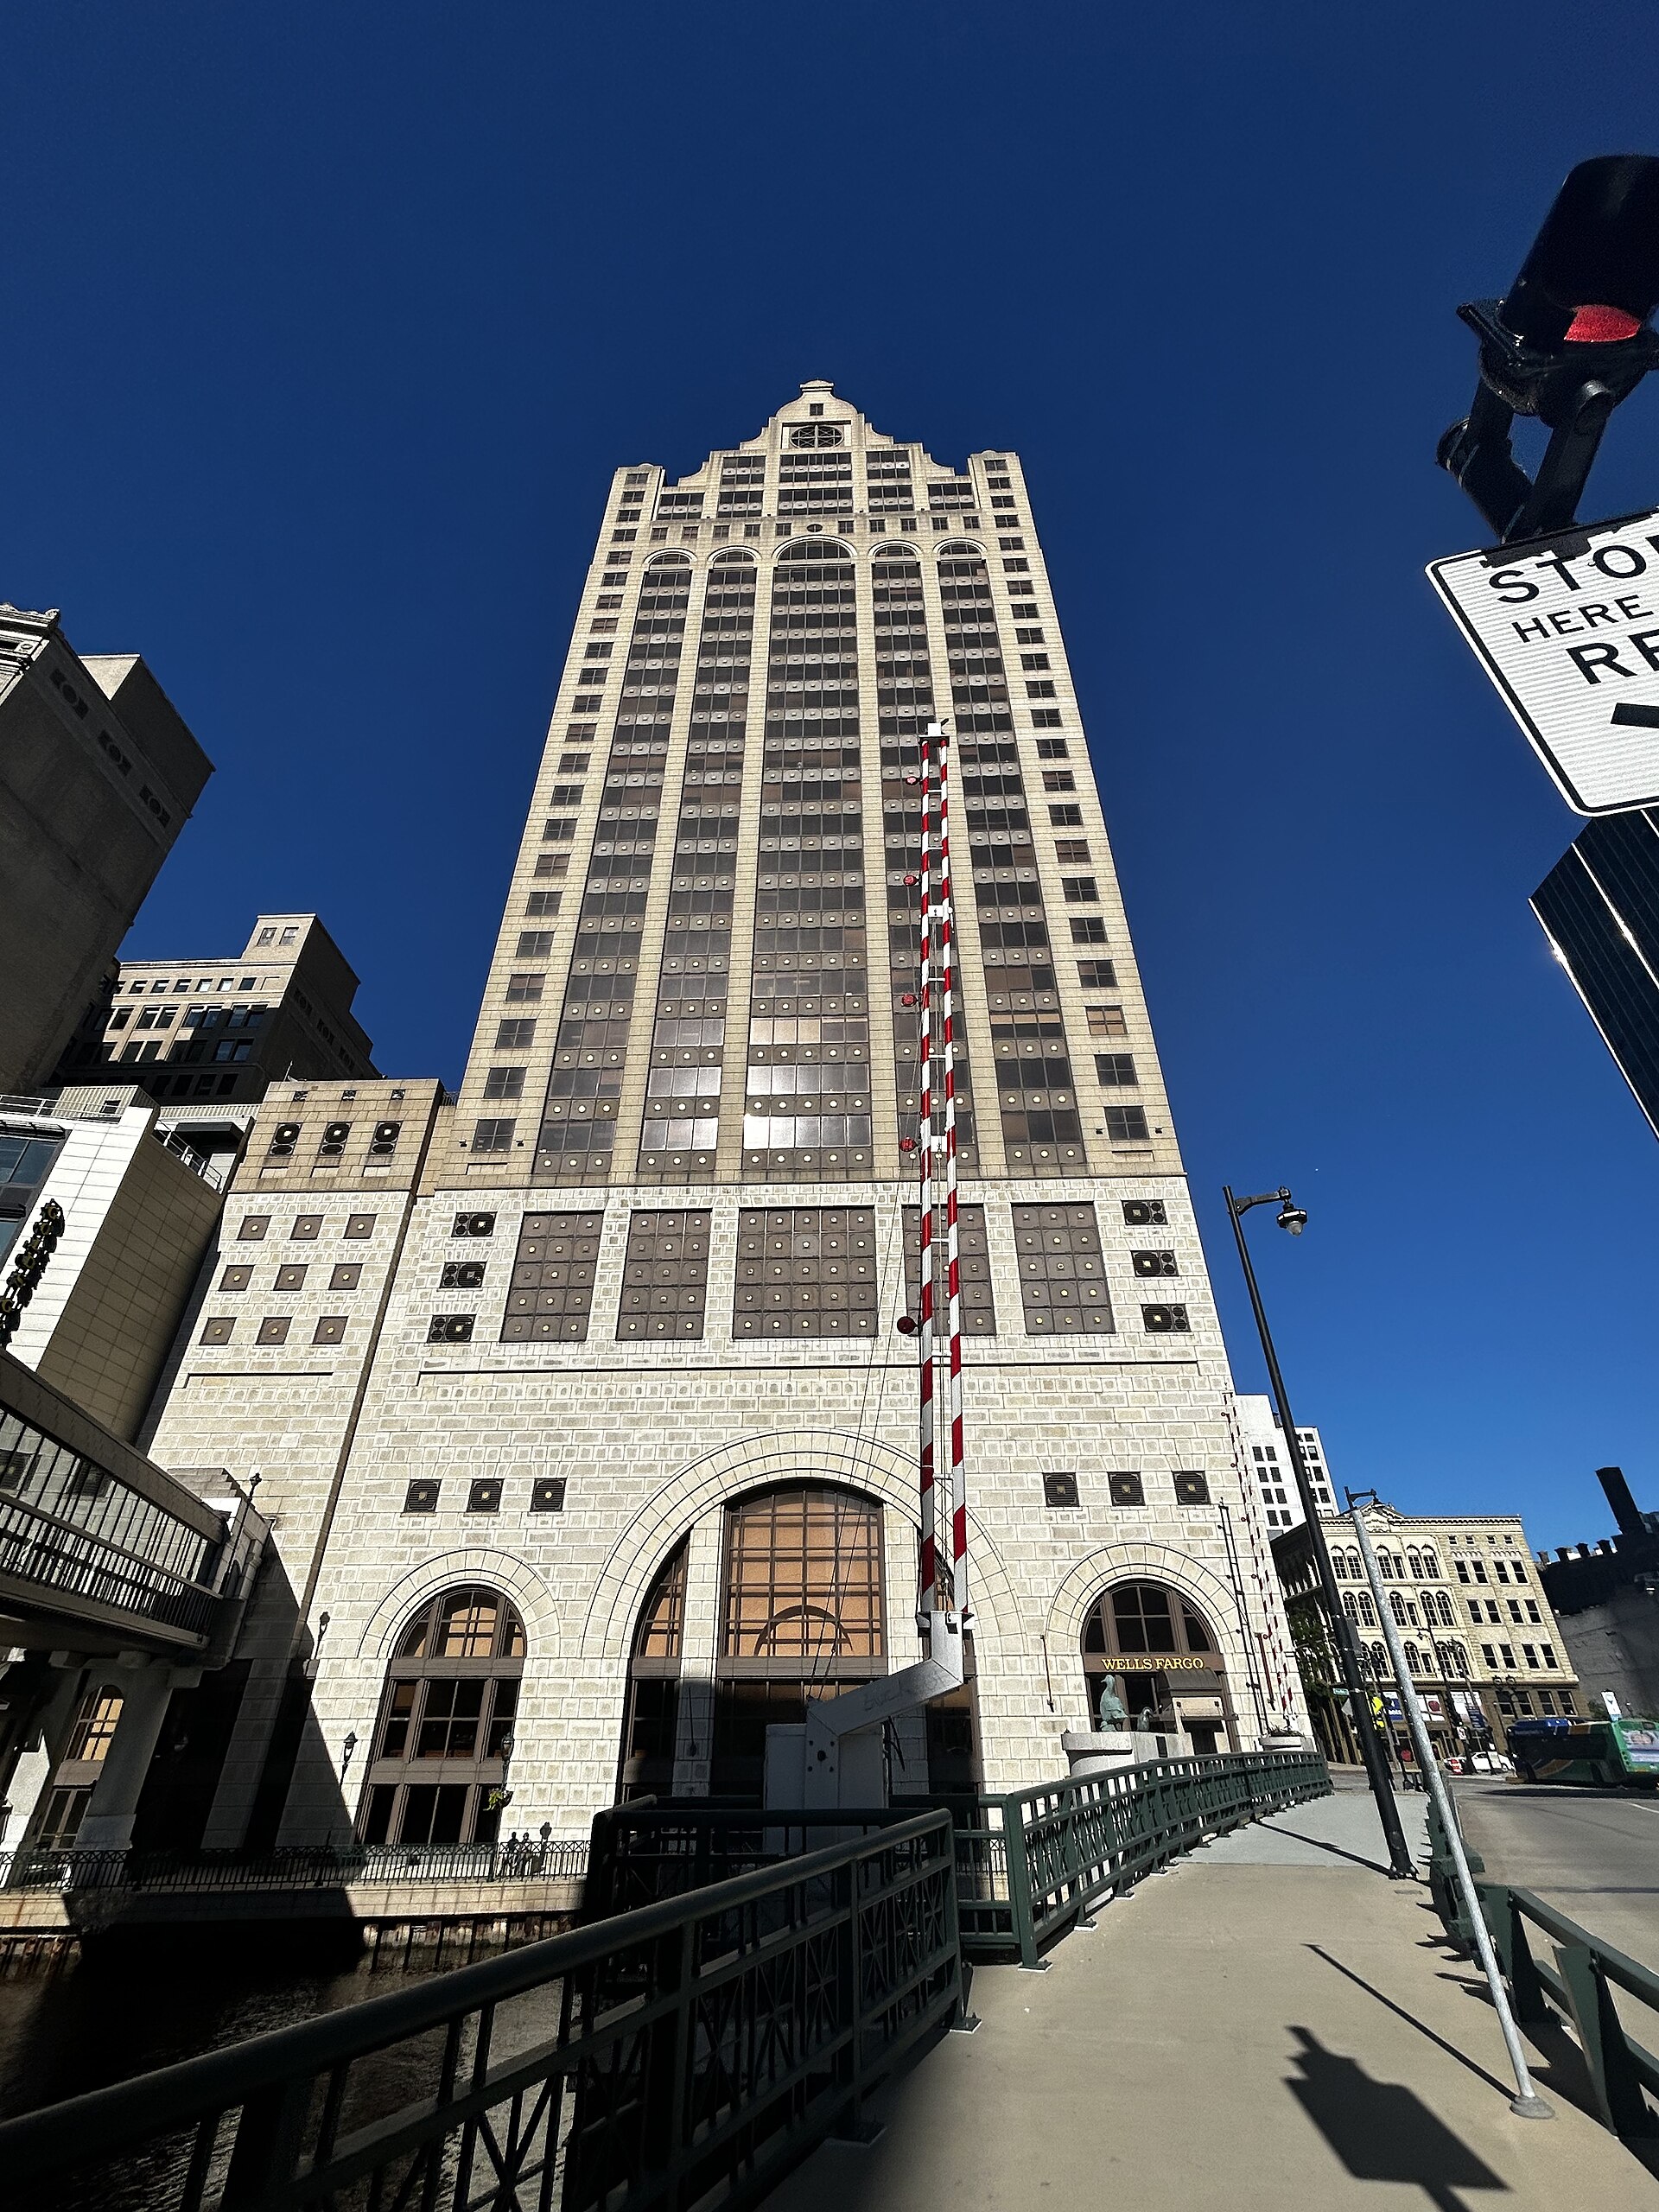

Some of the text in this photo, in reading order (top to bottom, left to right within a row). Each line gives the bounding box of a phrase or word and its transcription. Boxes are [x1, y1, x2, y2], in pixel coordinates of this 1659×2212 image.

[1489, 535, 1659, 603] STO
[1512, 594, 1654, 643] HERE
[1102, 1657, 1204, 1670] WELLS FARGO
